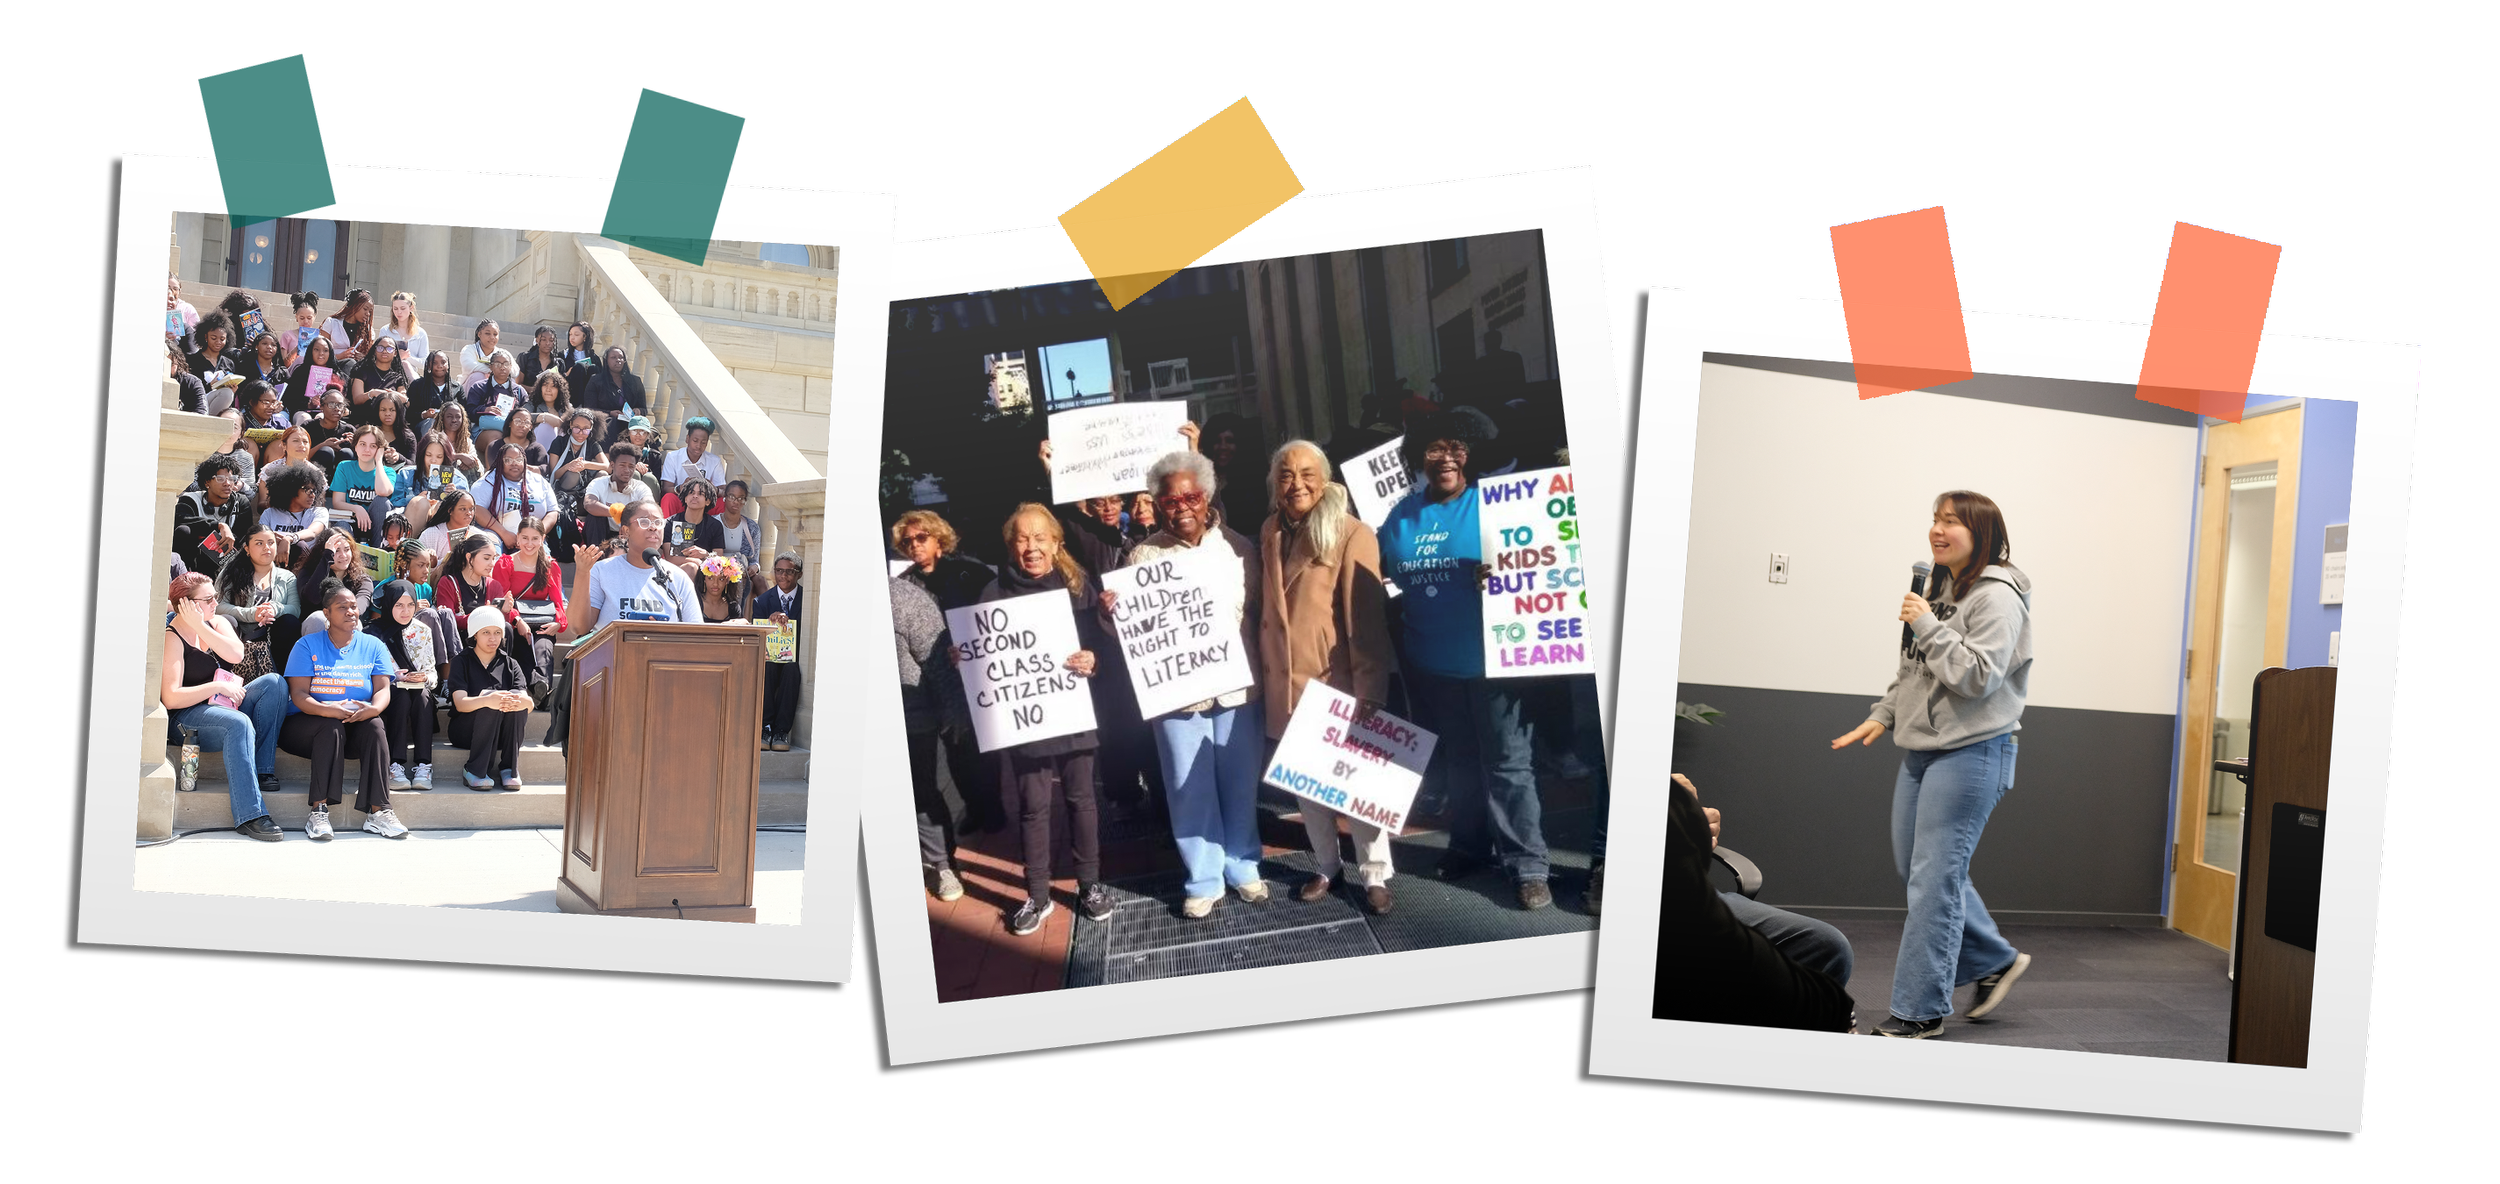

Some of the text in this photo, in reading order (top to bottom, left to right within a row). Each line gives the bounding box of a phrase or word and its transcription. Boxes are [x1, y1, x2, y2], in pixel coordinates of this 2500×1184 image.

[1482, 478, 1539, 505] WHY
[507, 502, 534, 512] FUD
[1413, 531, 1449, 544] STAND
[1433, 522, 1438, 530] I
[1500, 519, 1580, 548] TO S
[1416, 544, 1438, 556] FOR
[1497, 544, 1581, 571] KIDS T
[1135, 560, 1183, 587] OUR
[1396, 557, 1459, 574] EDUCATION
[1410, 571, 1450, 585] JUSTICE
[1488, 566, 1585, 596] BUT SC
[620, 598, 663, 612] FUND
[1514, 592, 1567, 614] NOT
[974, 608, 1008, 636] NO
[1121, 600, 1214, 640] HAVE THE
[1492, 617, 1583, 644] TO SEE
[958, 630, 1036, 661] SECOND
[1127, 622, 1210, 660] RIGHT TO
[986, 653, 1055, 682] CLASS
[1500, 643, 1584, 667] LEARN
[976, 672, 1077, 708] CITIZENS
[1013, 704, 1044, 730] NO
[1322, 726, 1396, 767] SLAVERY
[1332, 760, 1358, 780] BY
[1270, 763, 1401, 828] ANOTHER NAME
